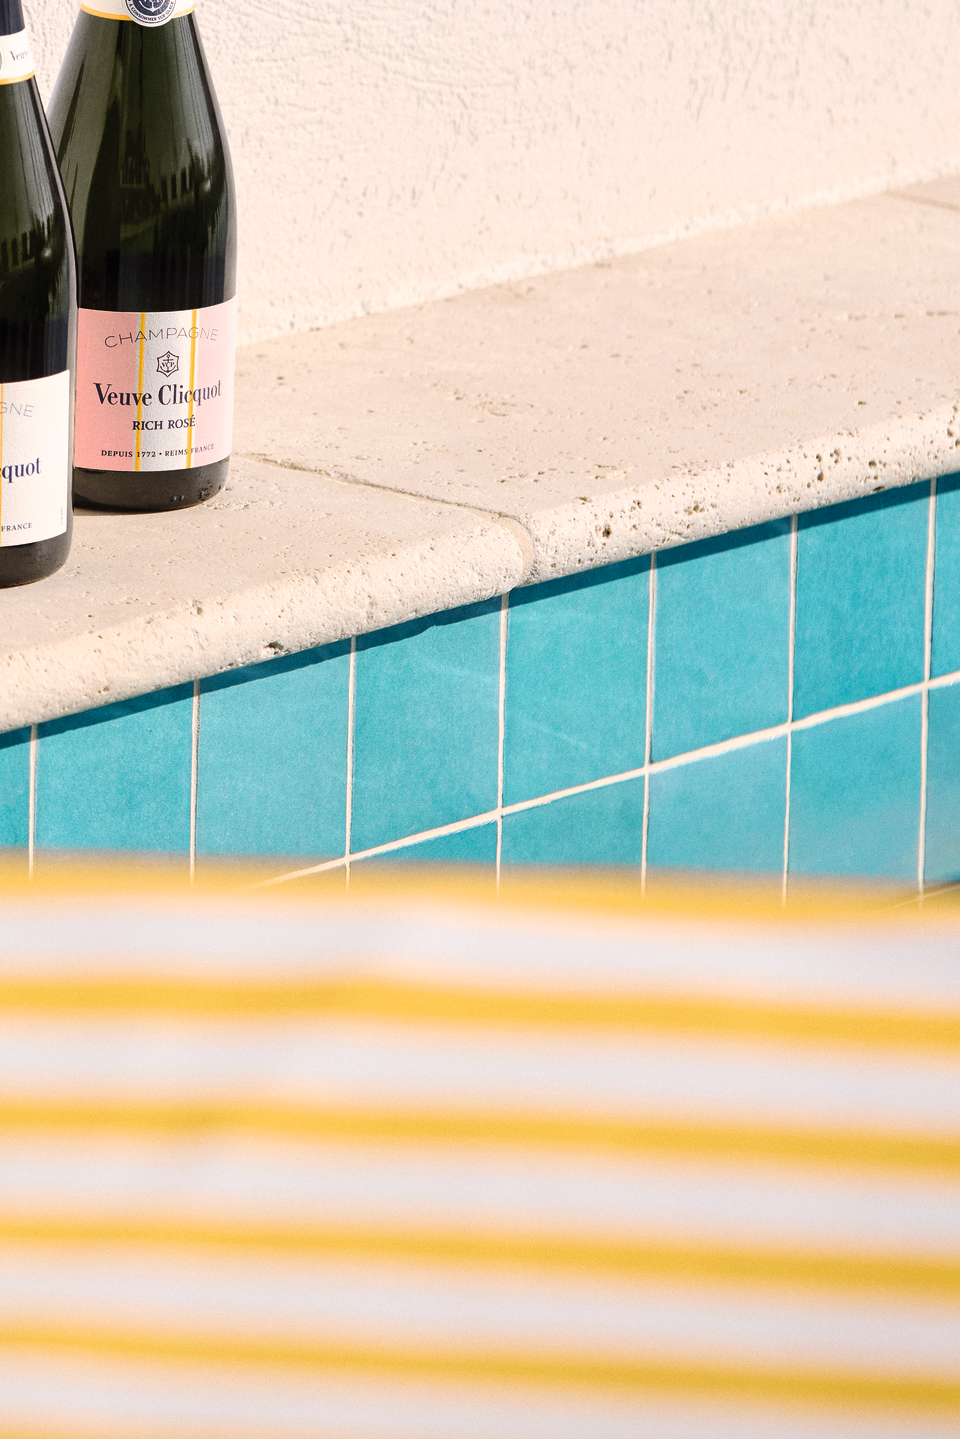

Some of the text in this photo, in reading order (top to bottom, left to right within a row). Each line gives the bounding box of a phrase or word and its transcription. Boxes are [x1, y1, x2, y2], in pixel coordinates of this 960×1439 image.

[104, 327, 219, 348] CHAMPAGNE
[93, 380, 222, 407] Veuve Clicquot
[132, 414, 196, 431] RICH ROSÉ
[101, 449, 133, 458] DEPUIS
[165, 448, 188, 457] REIMS
[191, 443, 215, 454] FRANCE
[1, 522, 33, 533] FRANCE
